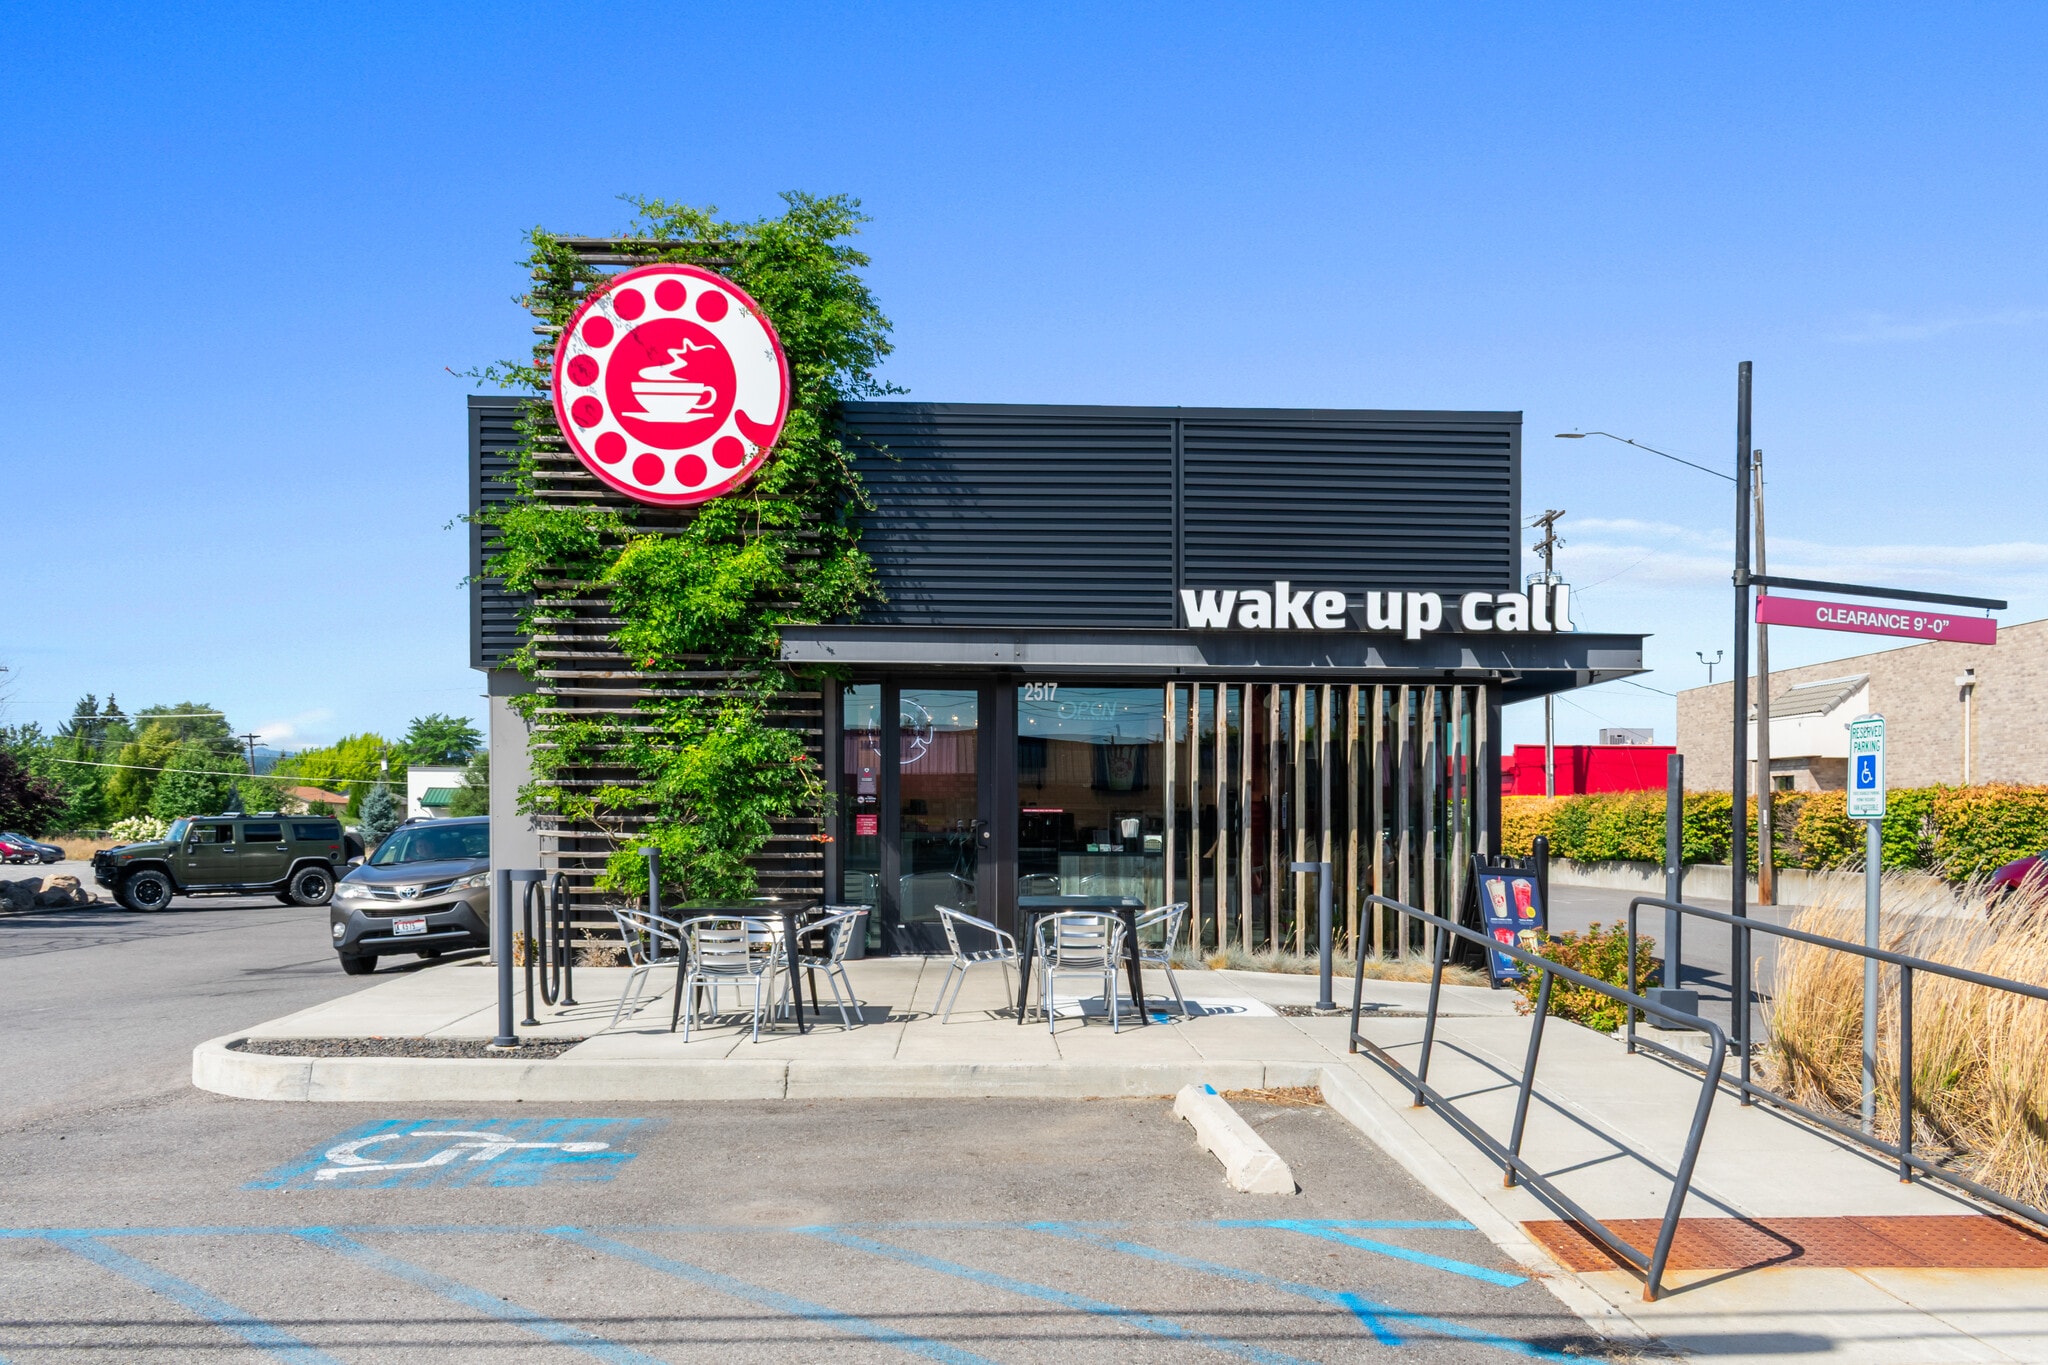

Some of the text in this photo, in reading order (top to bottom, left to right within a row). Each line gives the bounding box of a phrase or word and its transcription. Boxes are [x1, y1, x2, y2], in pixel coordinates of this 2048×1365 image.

[1180, 581, 1575, 640] wake up call
[1816, 607, 1910, 630] CLEARANCE
[1024, 682, 1058, 701] 2517
[1058, 701, 1117, 719] OPEN
[1852, 725, 1882, 739] RESERVED
[1854, 739, 1880, 753] PARKING
